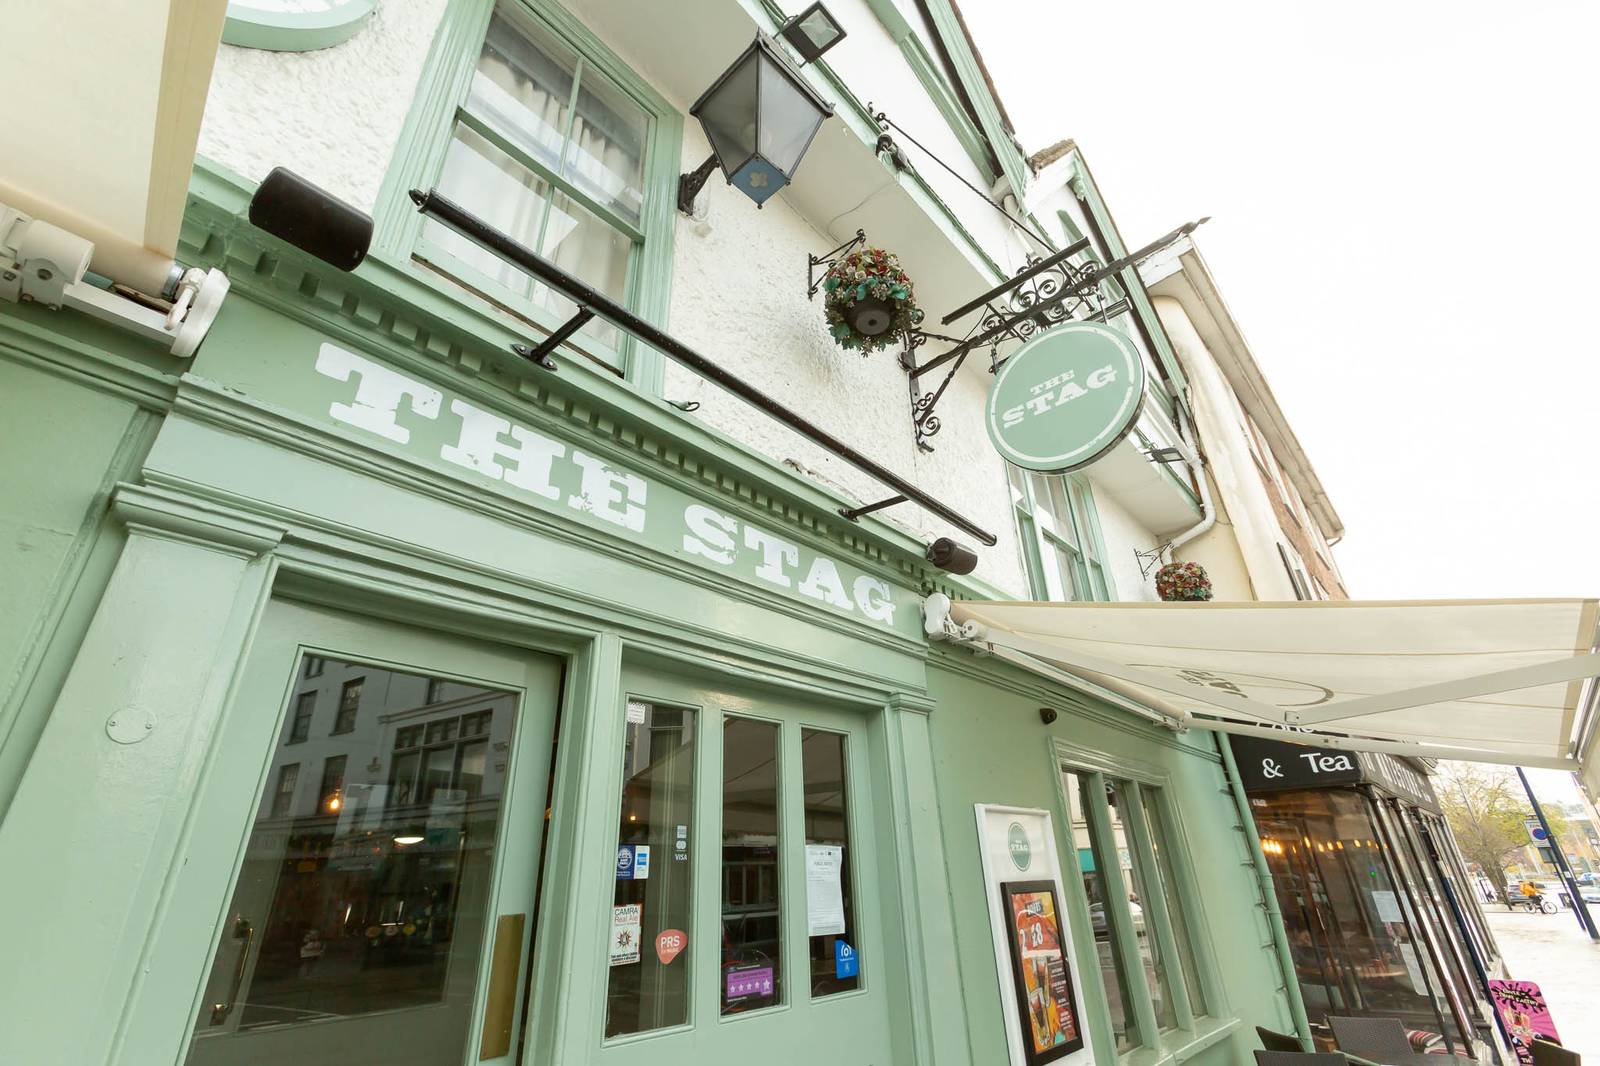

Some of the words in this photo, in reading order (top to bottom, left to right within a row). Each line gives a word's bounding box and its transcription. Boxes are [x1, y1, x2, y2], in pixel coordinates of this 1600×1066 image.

[1030, 370, 1075, 395] THE
[1002, 364, 1117, 429] STAG
[315, 342, 648, 533] THE
[683, 504, 896, 626] STAG
[1262, 758, 1284, 779] &
[1300, 752, 1354, 774] Tea
[675, 853, 687, 861] VISA
[614, 908, 638, 917] CAMRA
[660, 935, 680, 947] PRS
